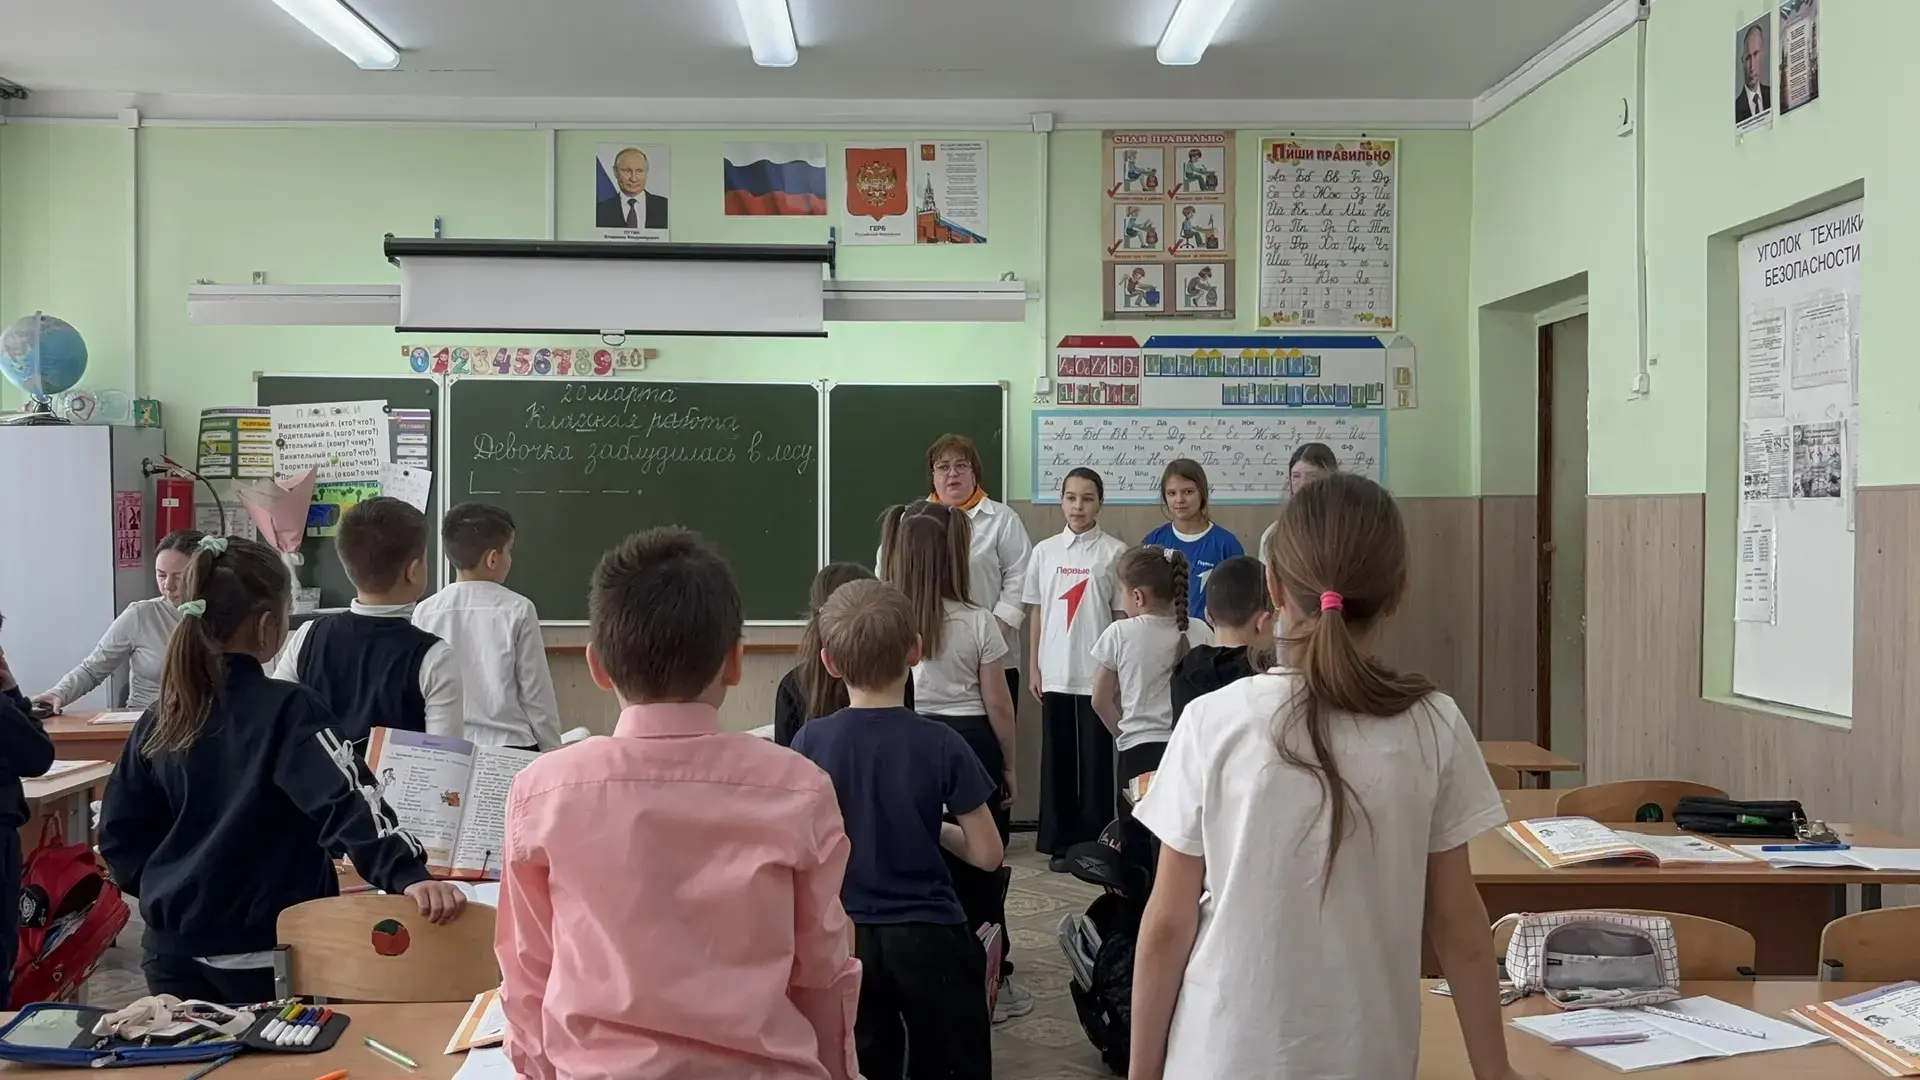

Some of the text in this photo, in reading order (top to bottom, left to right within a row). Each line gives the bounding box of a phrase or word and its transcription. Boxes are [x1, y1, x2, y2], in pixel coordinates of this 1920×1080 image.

[1113, 134, 1225, 143] СИДИ ПРАВИЛЬНО
[1267, 169, 1286, 182] Аа
[1296, 168, 1314, 182] Бб
[1324, 170, 1340, 182] Вв
[1372, 170, 1391, 186] Дд
[1313, 186, 1340, 198] Жж
[1351, 186, 1367, 204] Зз
[1374, 186, 1391, 199] Ии
[1267, 201, 1391, 216] Йй Кк Лл Мм Нн
[1266, 219, 1390, 237] Оо Пп Рр Сс Тт
[1266, 235, 1390, 253] Уу Фф Хх Цц Чч
[1758, 233, 1801, 262] УГОЛОК
[1266, 253, 1291, 266] Шш
[1304, 253, 1329, 268] Щщ
[1765, 244, 1860, 287] БЕЗОПАСНОСТИ
[1278, 270, 1370, 284] Ээ Юю Яя
[1280, 287, 1286, 295] 1
[1303, 287, 1308, 295] 2
[1325, 287, 1330, 295] 3
[1347, 287, 1352, 295] 4
[1280, 300, 1285, 308] 6
[1302, 301, 1308, 309] 7
[1346, 301, 1352, 309] 9
[410, 347, 430, 373] 0
[432, 347, 450, 373] 1
[451, 347, 470, 374] 2
[472, 348, 490, 373] 3
[493, 348, 511, 374] 4
[512, 348, 530, 374] 5
[534, 348, 551, 374] 6
[552, 349, 572, 375] 7
[574, 349, 592, 375] 8
[594, 349, 612, 375] 9
[561, 384, 678, 413] 20 марта
[278, 420, 329, 430] Именительный
[338, 419, 356, 428] (кто?
[357, 418, 376, 426] что?)
[646, 407, 740, 438] работа
[279, 431, 324, 440] Родительный
[334, 429, 355, 438] (кого?
[357, 428, 379, 436] чего?)
[1053, 428, 1072, 440] Аа
[1082, 427, 1102, 440] Бб
[1110, 428, 1128, 440] Вв
[1138, 427, 1154, 440] Гг
[1167, 426, 1186, 444] Дд
[1200, 426, 1213, 440] Ее
[1250, 428, 1280, 440] Жж
[1288, 427, 1303, 444] Зз
[1316, 427, 1332, 439] Ии
[326, 439, 349, 448] (кому?
[351, 438, 374, 446] чему?)
[280, 451, 326, 460] Винительный
[335, 449, 356, 457] (кого?
[358, 448, 376, 456] что?)
[474, 431, 574, 460] Девочка
[585, 435, 736, 474] заблудилась
[748, 431, 762, 463] в
[340, 460, 358, 468] (кем?
[1053, 453, 1071, 465] Кк
[1080, 454, 1100, 465] Лл
[1109, 452, 1136, 465] Мм
[1146, 452, 1165, 465] Нн
[1200, 451, 1220, 465] Пп
[1232, 452, 1251, 470] Рр
[1263, 452, 1278, 465] Сс
[1354, 452, 1374, 469] Фф
[1118, 476, 1135, 490] Чч
[1056, 566, 1090, 576] Первые
